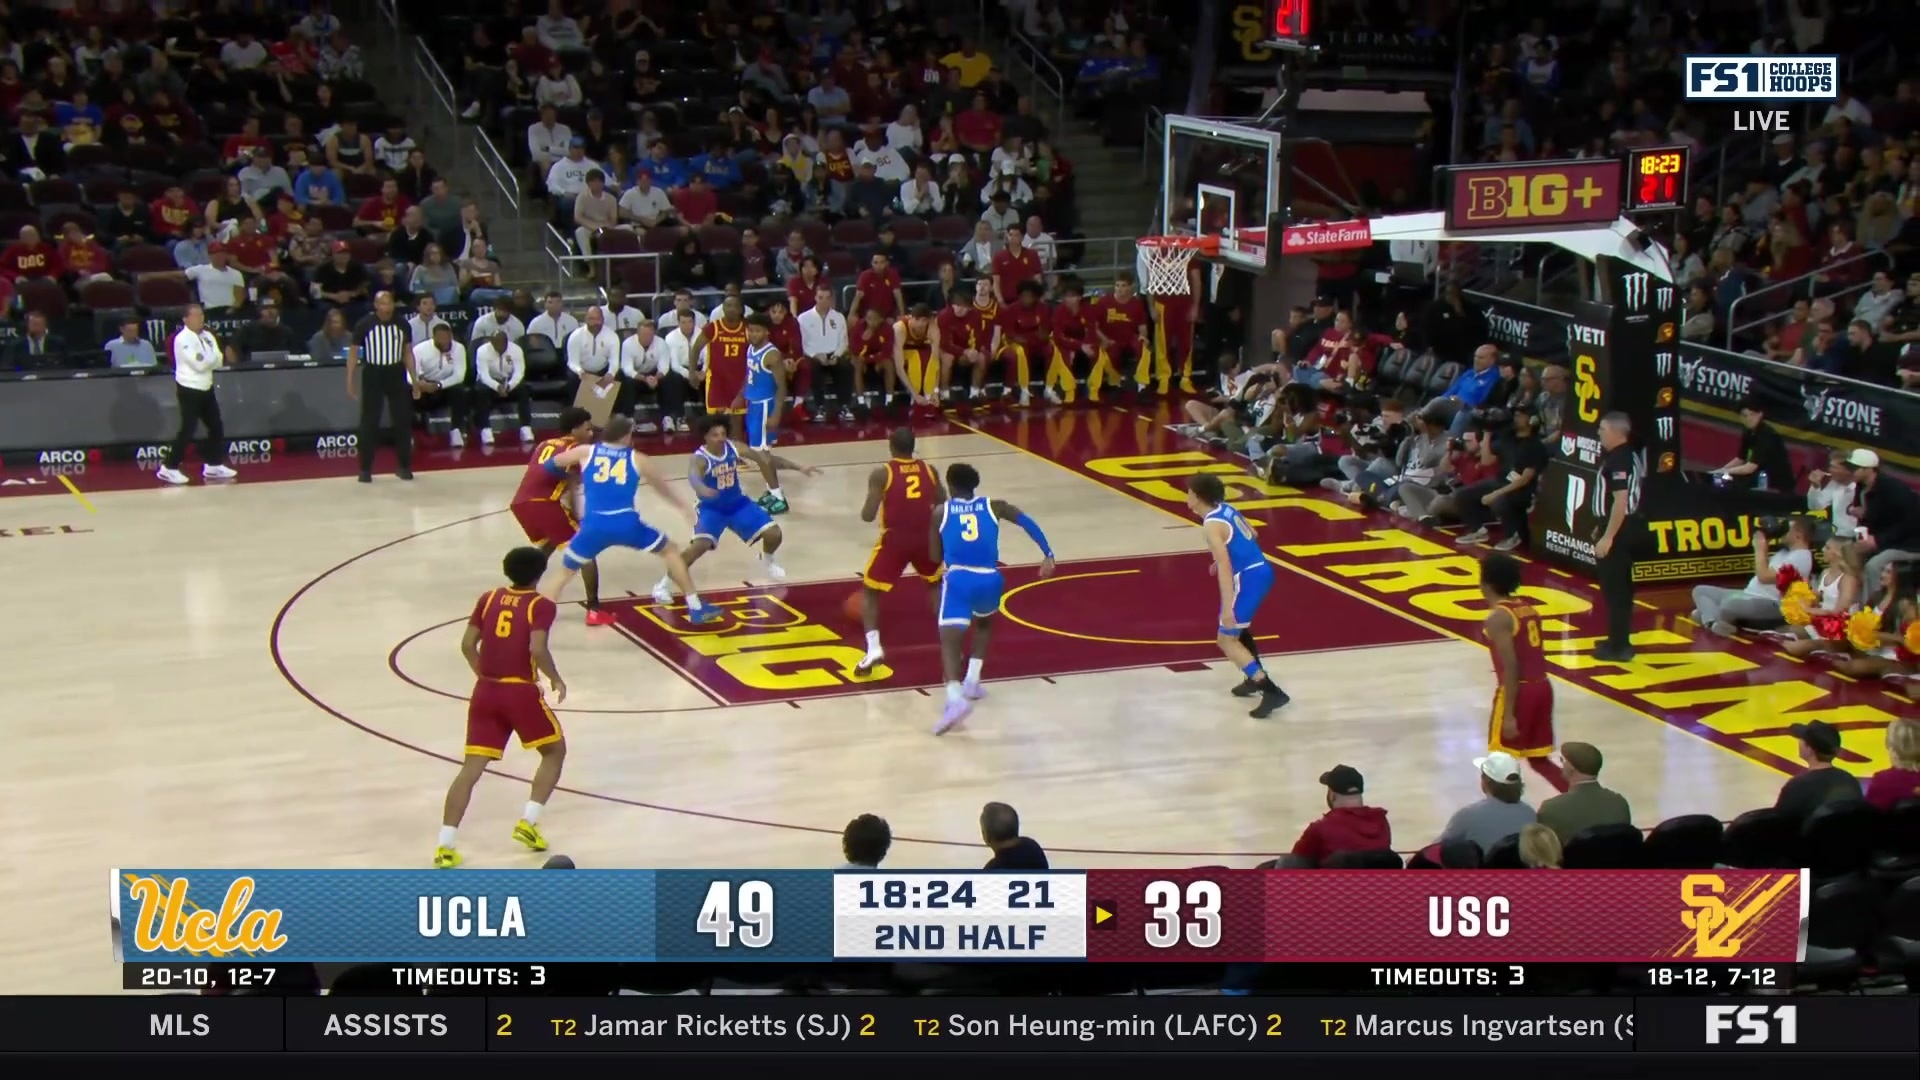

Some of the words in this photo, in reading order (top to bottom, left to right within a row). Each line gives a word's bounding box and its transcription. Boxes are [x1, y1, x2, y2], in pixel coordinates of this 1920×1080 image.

[1641, 154, 1681, 175] 18:23
[1641, 174, 1674, 201] 21
[1488, 314, 1530, 339] STONE
[1574, 324, 1605, 347] YETI
[724, 344, 740, 357] 13
[1575, 355, 1601, 423] SC
[1697, 366, 1754, 394] STONE
[1825, 397, 1881, 426] STONE
[136, 446, 172, 459] ARC
[229, 440, 271, 453] ARCO
[317, 435, 358, 449] ARCO
[39, 450, 86, 464] ARCO
[593, 456, 628, 485] 34
[906, 475, 921, 498] 2
[960, 514, 979, 541] 3
[1546, 530, 1596, 556] PECHANGA
[495, 610, 513, 638] 6
[1527, 620, 1541, 648] 8
